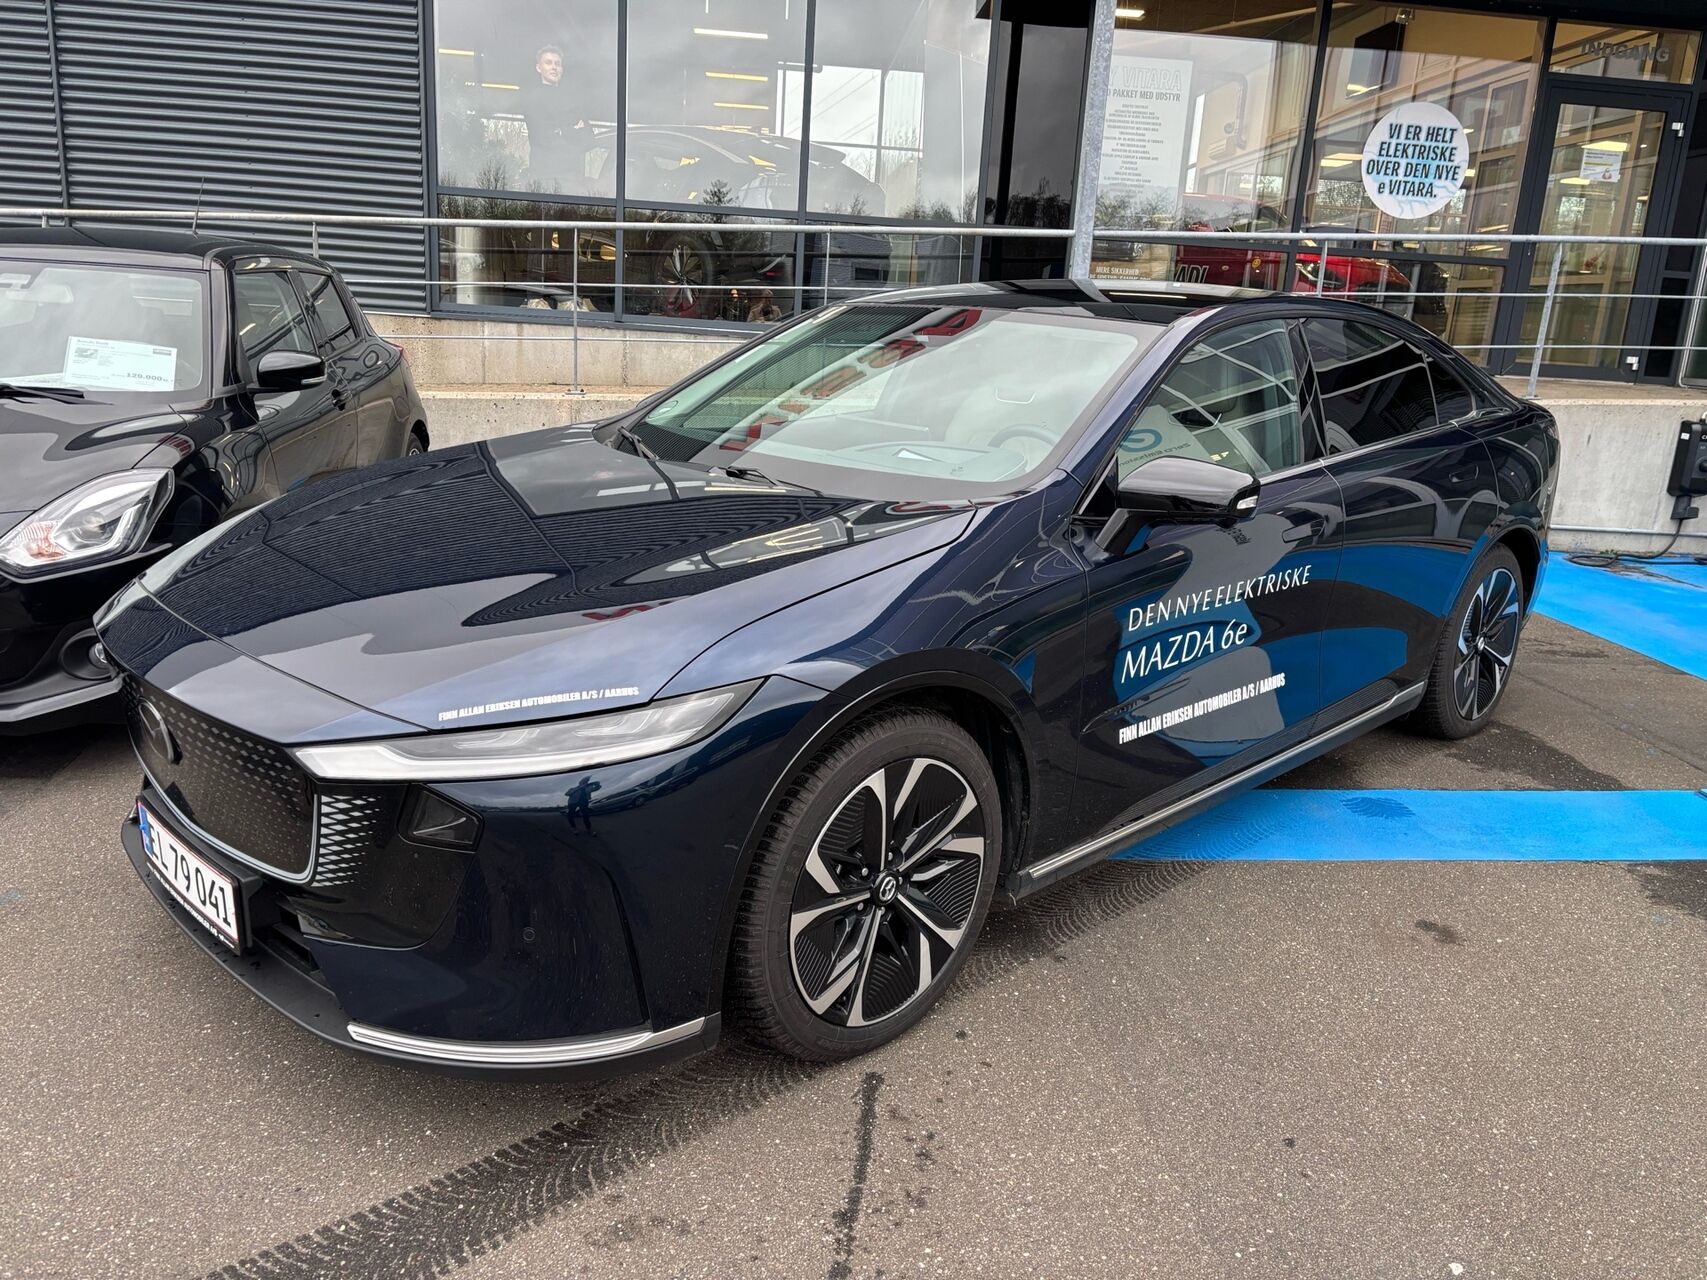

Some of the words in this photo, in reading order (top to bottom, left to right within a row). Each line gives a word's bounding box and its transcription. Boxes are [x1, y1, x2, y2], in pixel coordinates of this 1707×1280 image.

[1581, 41, 1669, 62] INDGANG
[1123, 66, 1182, 91] VITARA
[1112, 88, 1138, 99] PAKKET
[1140, 90, 1154, 100] MED
[1156, 92, 1181, 102] UDSTYR
[1389, 123, 1402, 139] VI
[1405, 125, 1422, 140] ER
[1426, 126, 1457, 144] HELT
[1378, 142, 1457, 162] ELEKTRISKE
[1366, 160, 1400, 176] OVER
[1404, 162, 1431, 178] DEN
[1434, 165, 1460, 181] NYE
[1378, 182, 1385, 194] e
[1389, 180, 1437, 198] VITARA.
[1128, 600, 1171, 632] DEN
[1175, 589, 1212, 618] NYE
[1215, 565, 1312, 608] ELEKTRISKE
[1121, 625, 1214, 684] MAZDA
[1222, 619, 1247, 649] 6e
[439, 710, 458, 721] FINN
[459, 705, 484, 718] ALLAN
[485, 701, 521, 714] ERIKSEN
[522, 693, 581, 707] AUTOMOBILER
[582, 690, 598, 700] A/S
[605, 686, 639, 697] AARHUS
[1119, 725, 1138, 744] FINN
[1138, 718, 1162, 737] ALLAN
[1163, 705, 1193, 728] ERIKSEN
[1194, 689, 1242, 717] AUTOMOBILER
[1242, 683, 1255, 699] A/S
[1259, 672, 1286, 692] AARHUS
[150, 824, 168, 871] EL
[169, 843, 191, 893] 79
[195, 866, 232, 928] 041
